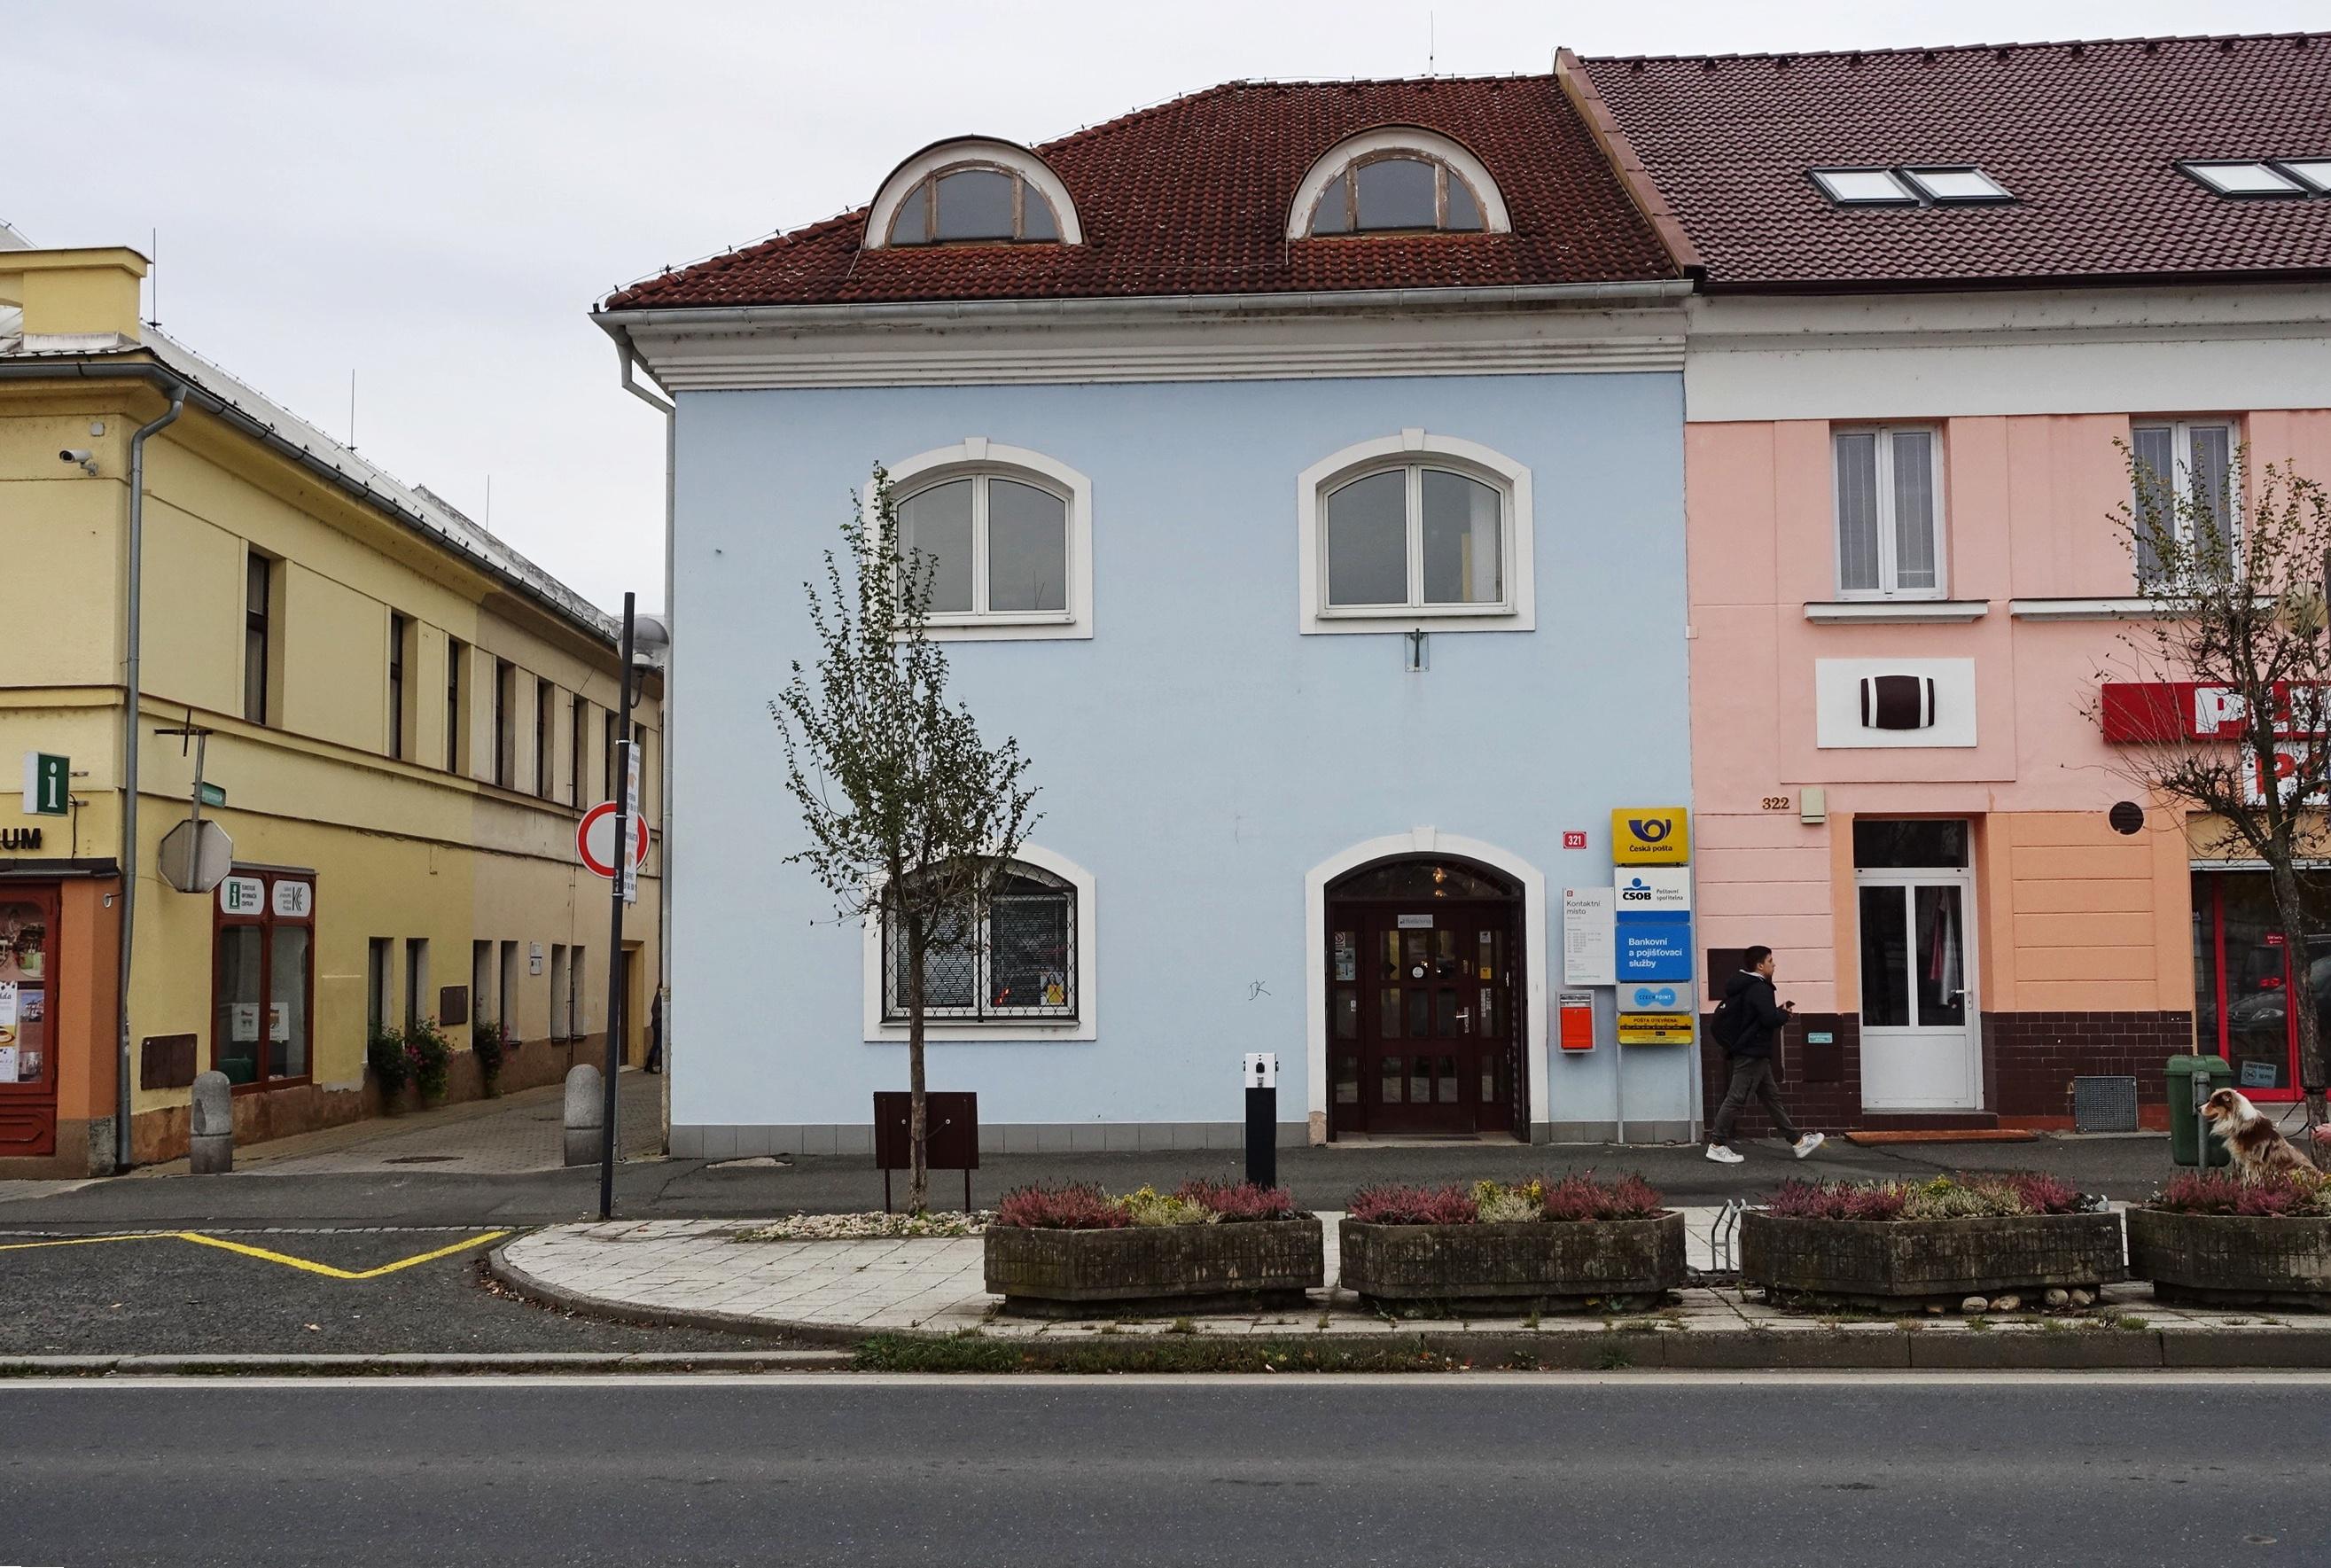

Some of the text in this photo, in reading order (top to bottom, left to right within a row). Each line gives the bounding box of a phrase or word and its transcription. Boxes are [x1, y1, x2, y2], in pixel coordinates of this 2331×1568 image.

[1762, 797, 1790, 810] 322
[0, 827, 42, 850] UM
[1568, 835, 1582, 846] 321
[1629, 844, 1651, 853] Česká
[1622, 891, 1652, 901] ČSOB
[1628, 937, 1668, 946] Bankovní
[1636, 948, 1682, 958] pojišťovací
[1628, 959, 1657, 969] služby
